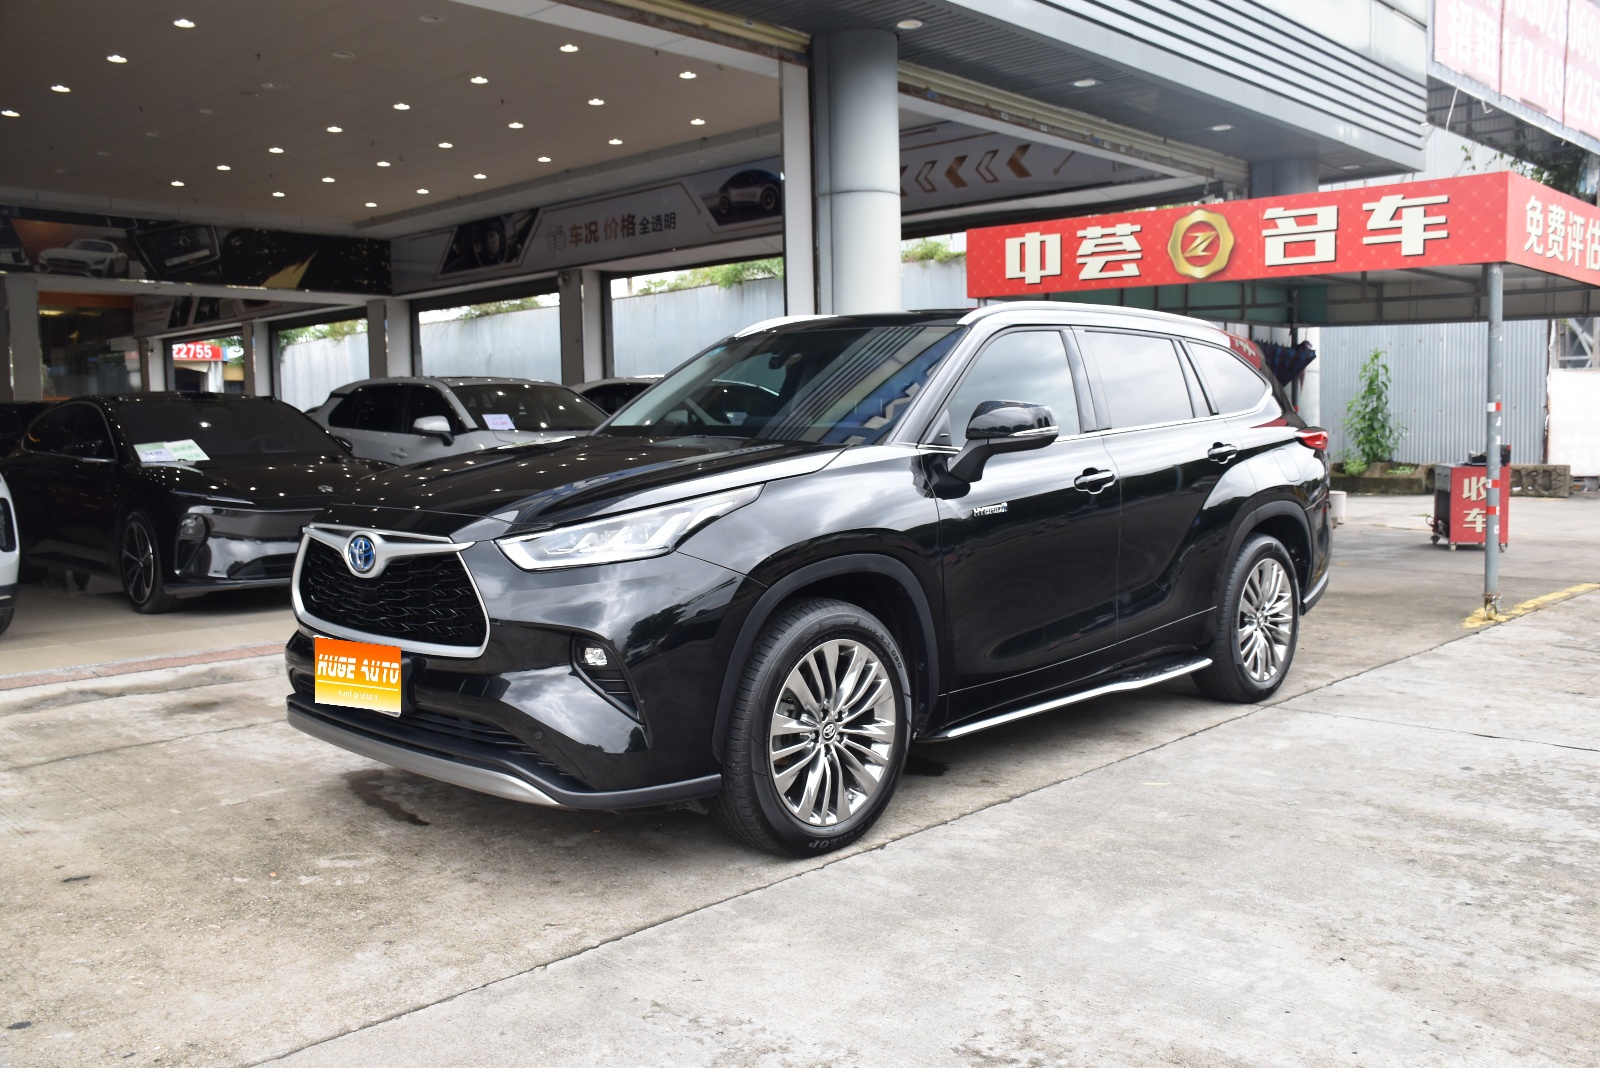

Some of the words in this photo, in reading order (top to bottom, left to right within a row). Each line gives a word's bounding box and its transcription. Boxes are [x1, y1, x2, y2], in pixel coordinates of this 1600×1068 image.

[569, 221, 599, 247] 车况
[604, 213, 636, 241] 价格
[639, 212, 676, 235] 全透明
[1005, 224, 1142, 285] 中荟
[1262, 194, 1450, 267] 名车
[1524, 195, 1600, 271] 免费评估
